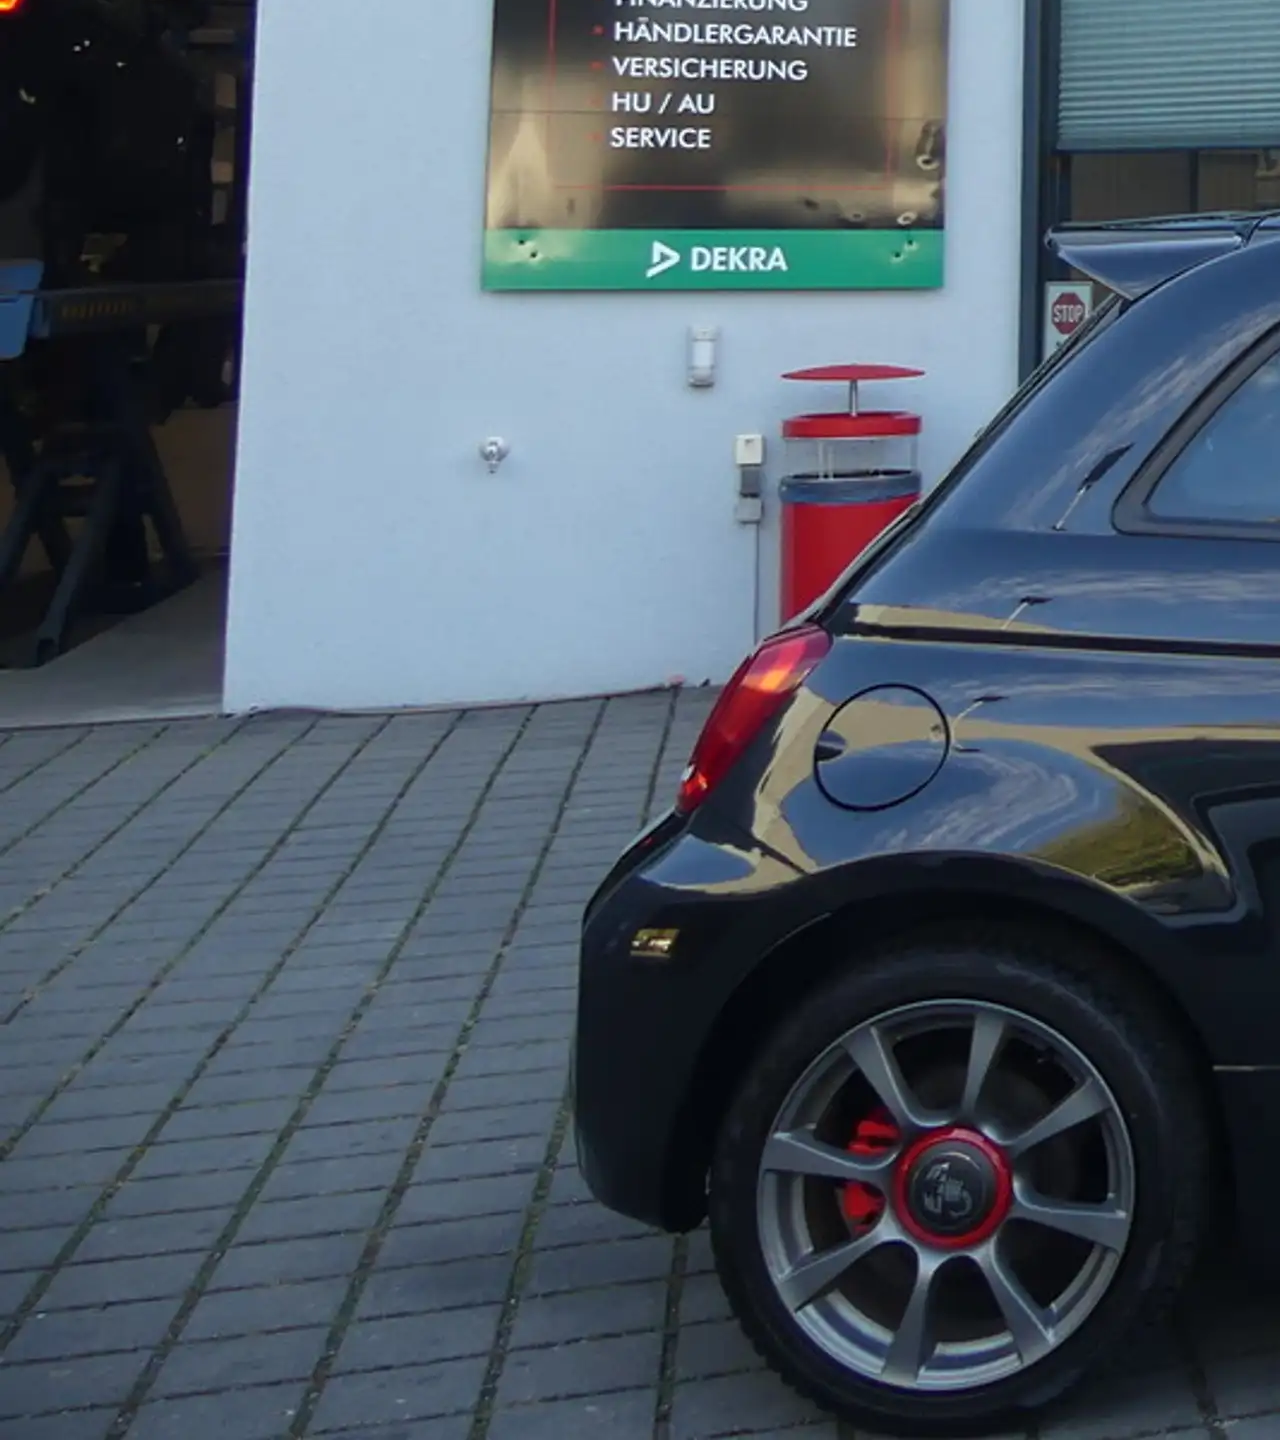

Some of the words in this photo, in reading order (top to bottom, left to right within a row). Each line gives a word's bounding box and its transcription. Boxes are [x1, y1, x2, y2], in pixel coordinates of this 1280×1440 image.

[613, 17, 858, 48] HÄNDLERGARANTIE
[612, 56, 809, 82] VERSICHERUNG
[611, 91, 652, 114] HU
[658, 92, 673, 116] /
[677, 92, 716, 115] AU
[609, 126, 712, 150] SERVICE
[690, 245, 789, 273] DEKRA
